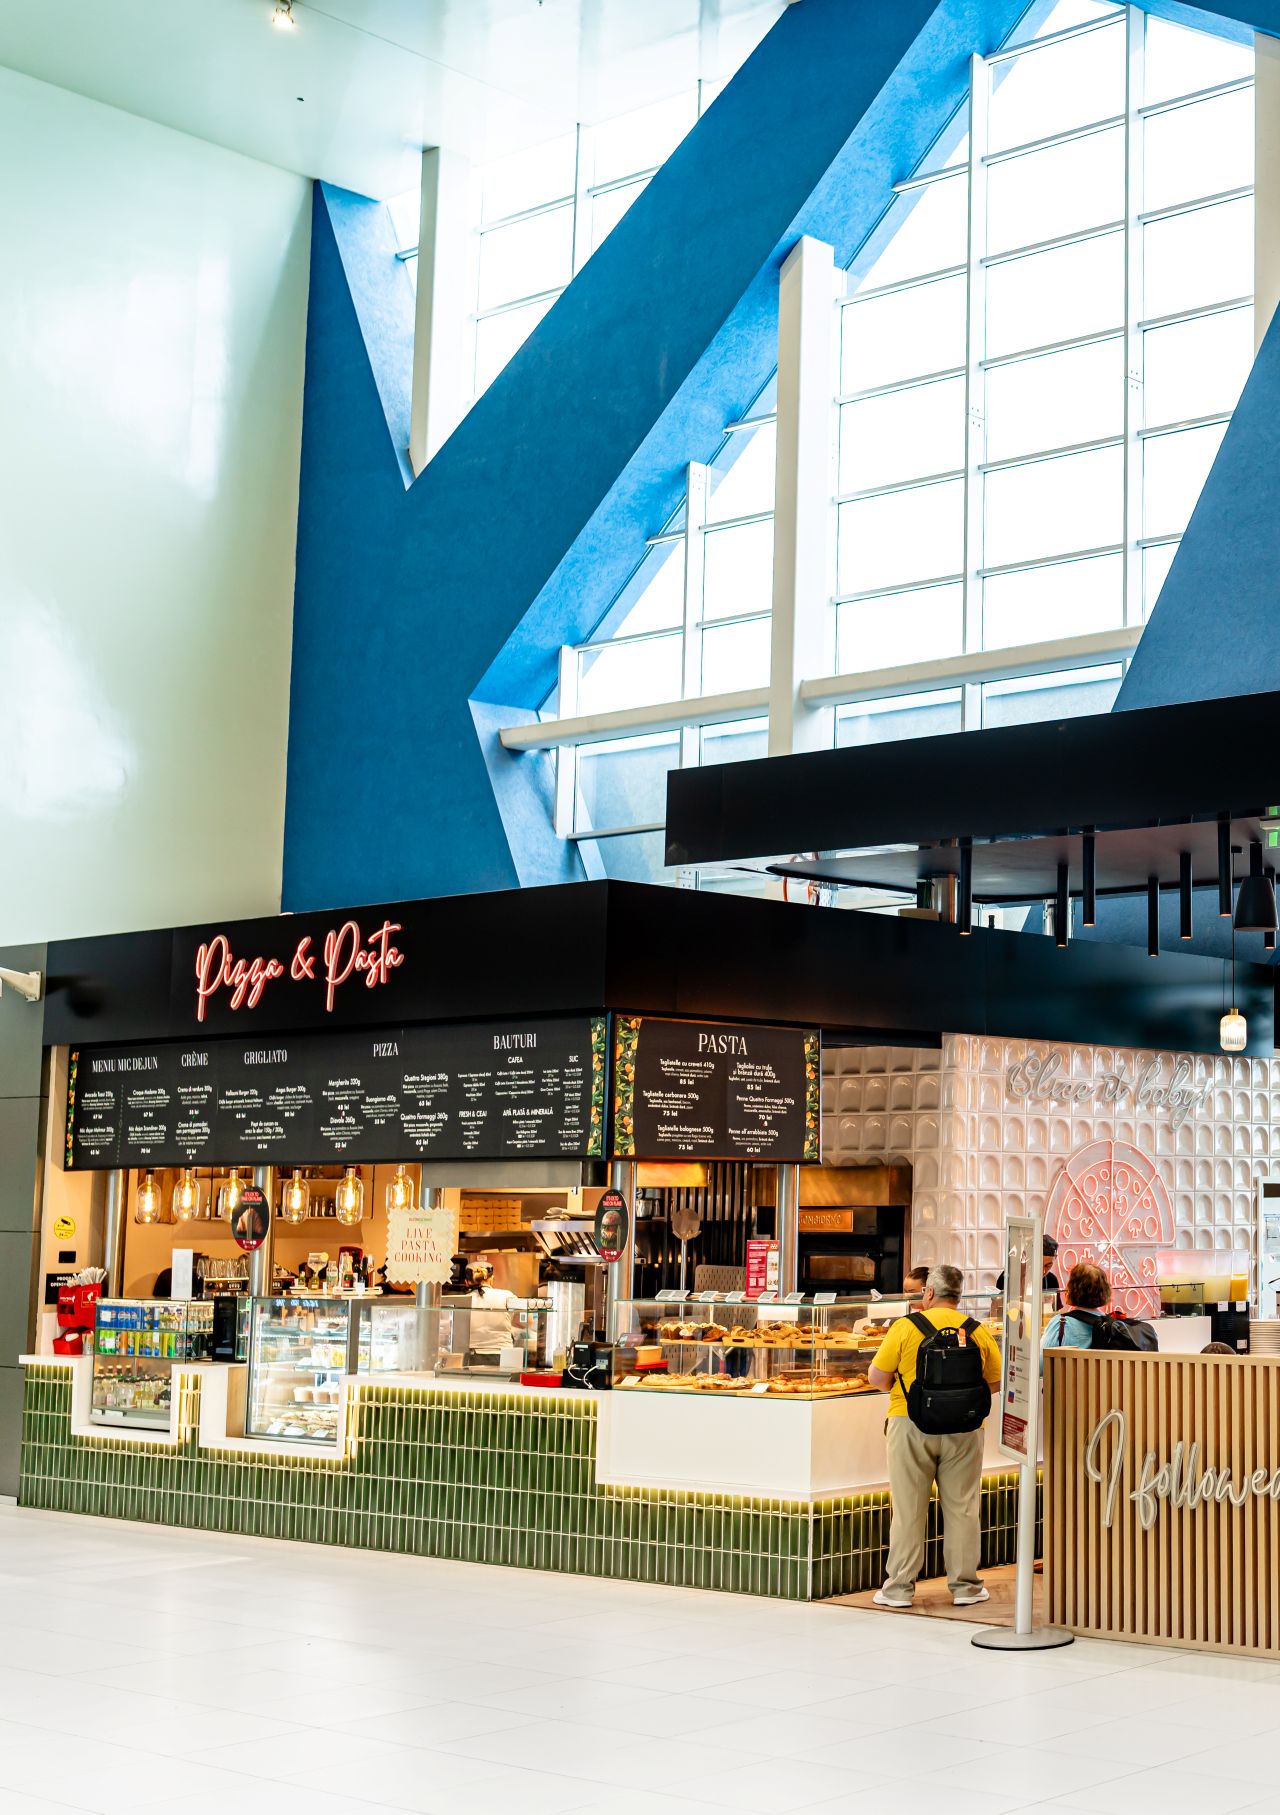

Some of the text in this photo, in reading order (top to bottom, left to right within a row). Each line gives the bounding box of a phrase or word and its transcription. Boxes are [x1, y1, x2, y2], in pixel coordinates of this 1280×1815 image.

[196, 920, 404, 1023] Pizza & Pasta
[493, 1033, 537, 1050] BAUTURI
[698, 1033, 748, 1056] PASTA
[244, 1049, 288, 1065] GRIGLIATO
[373, 1043, 399, 1057] PIZZA
[92, 1056, 158, 1073] MENIU MIC DEJUN
[181, 1052, 209, 1067] CRÈME
[507, 1056, 524, 1064] CAFEA
[406, 1227, 433, 1239] LIVE
[401, 1240, 436, 1251] PASTA
[394, 1252, 442, 1264] COOKING
[1084, 1408, 1126, 1527] I
